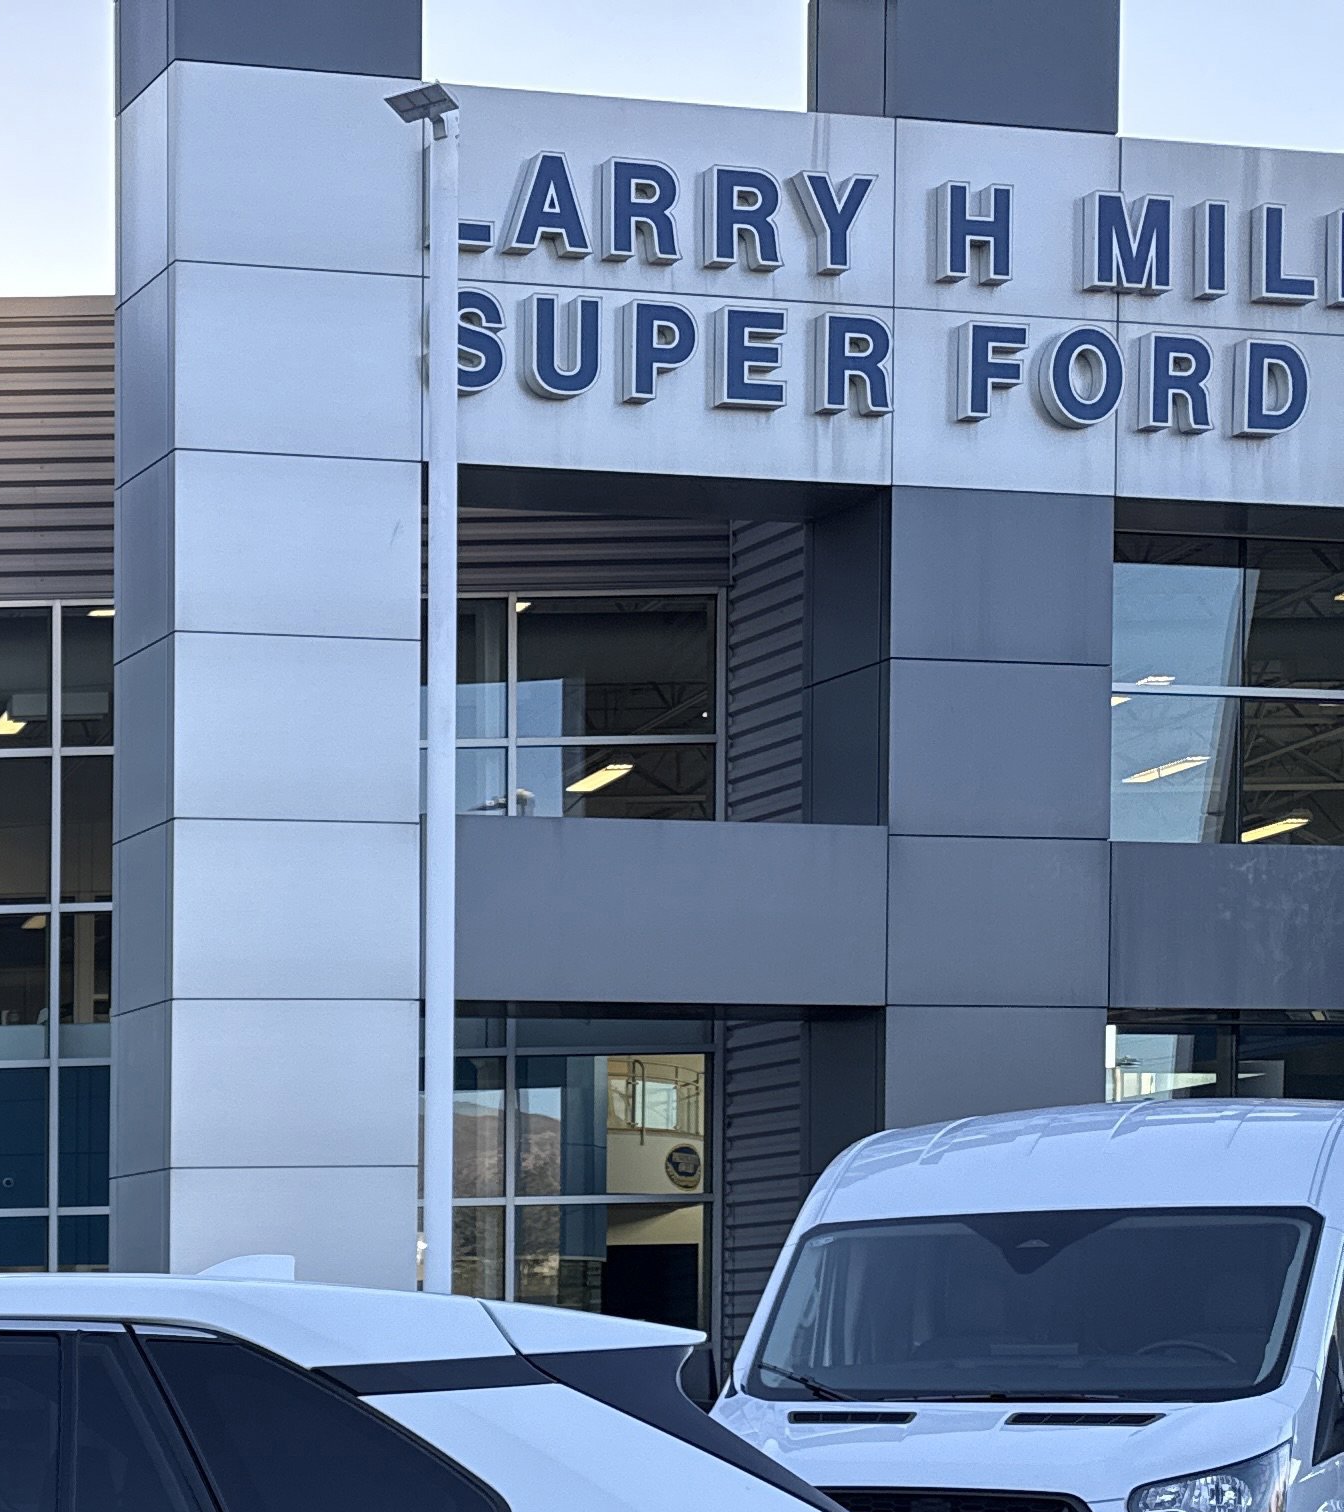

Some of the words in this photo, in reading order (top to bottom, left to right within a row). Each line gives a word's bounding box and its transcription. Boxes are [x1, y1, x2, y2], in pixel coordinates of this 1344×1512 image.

[457, 150, 878, 276] ARRY
[934, 180, 1014, 284] H
[1080, 190, 1344, 308] MIL
[457, 287, 894, 417] SUPER
[956, 320, 1310, 440] FORD
